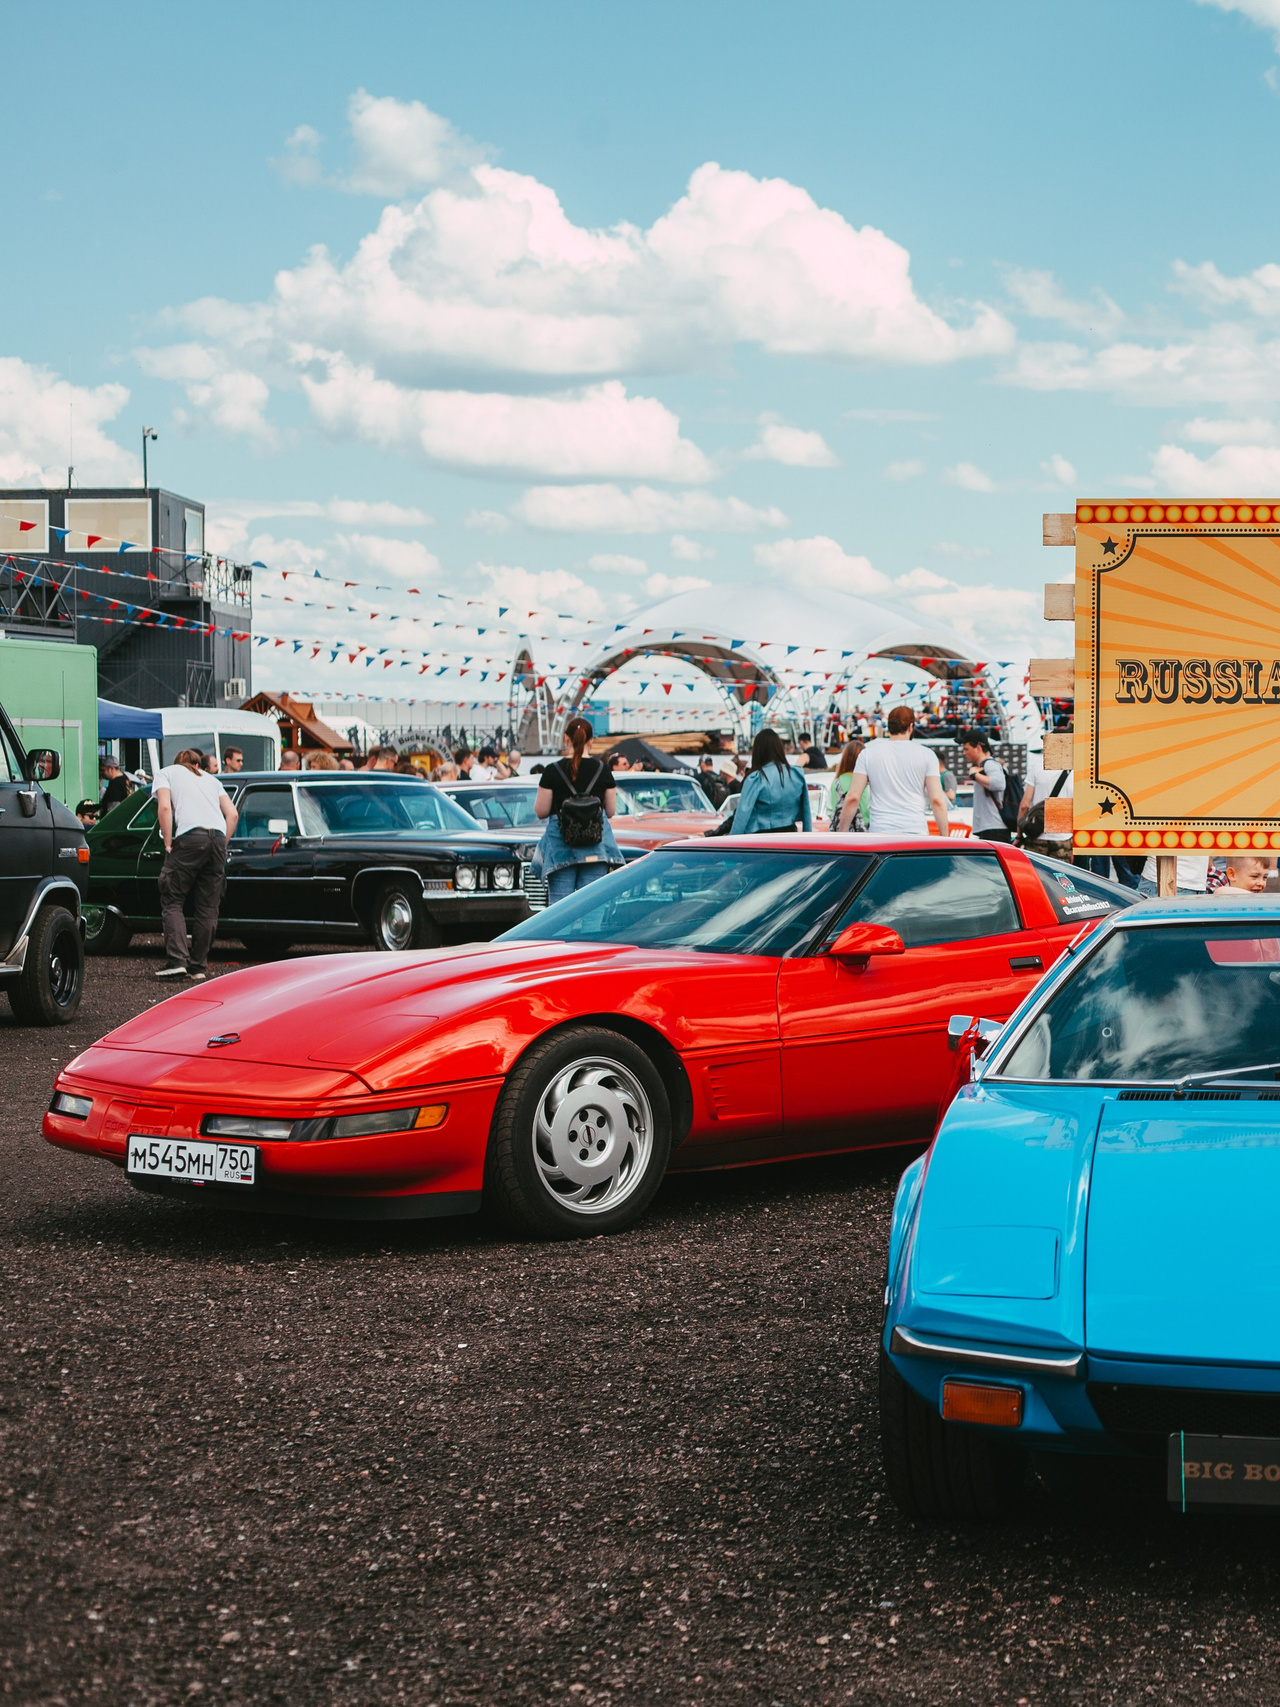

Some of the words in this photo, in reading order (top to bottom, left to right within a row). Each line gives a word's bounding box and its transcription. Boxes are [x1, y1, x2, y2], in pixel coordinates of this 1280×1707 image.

[218, 1147, 250, 1171] 750
[224, 1170, 240, 1180] RUS
[1182, 1461, 1235, 1481] BIG
